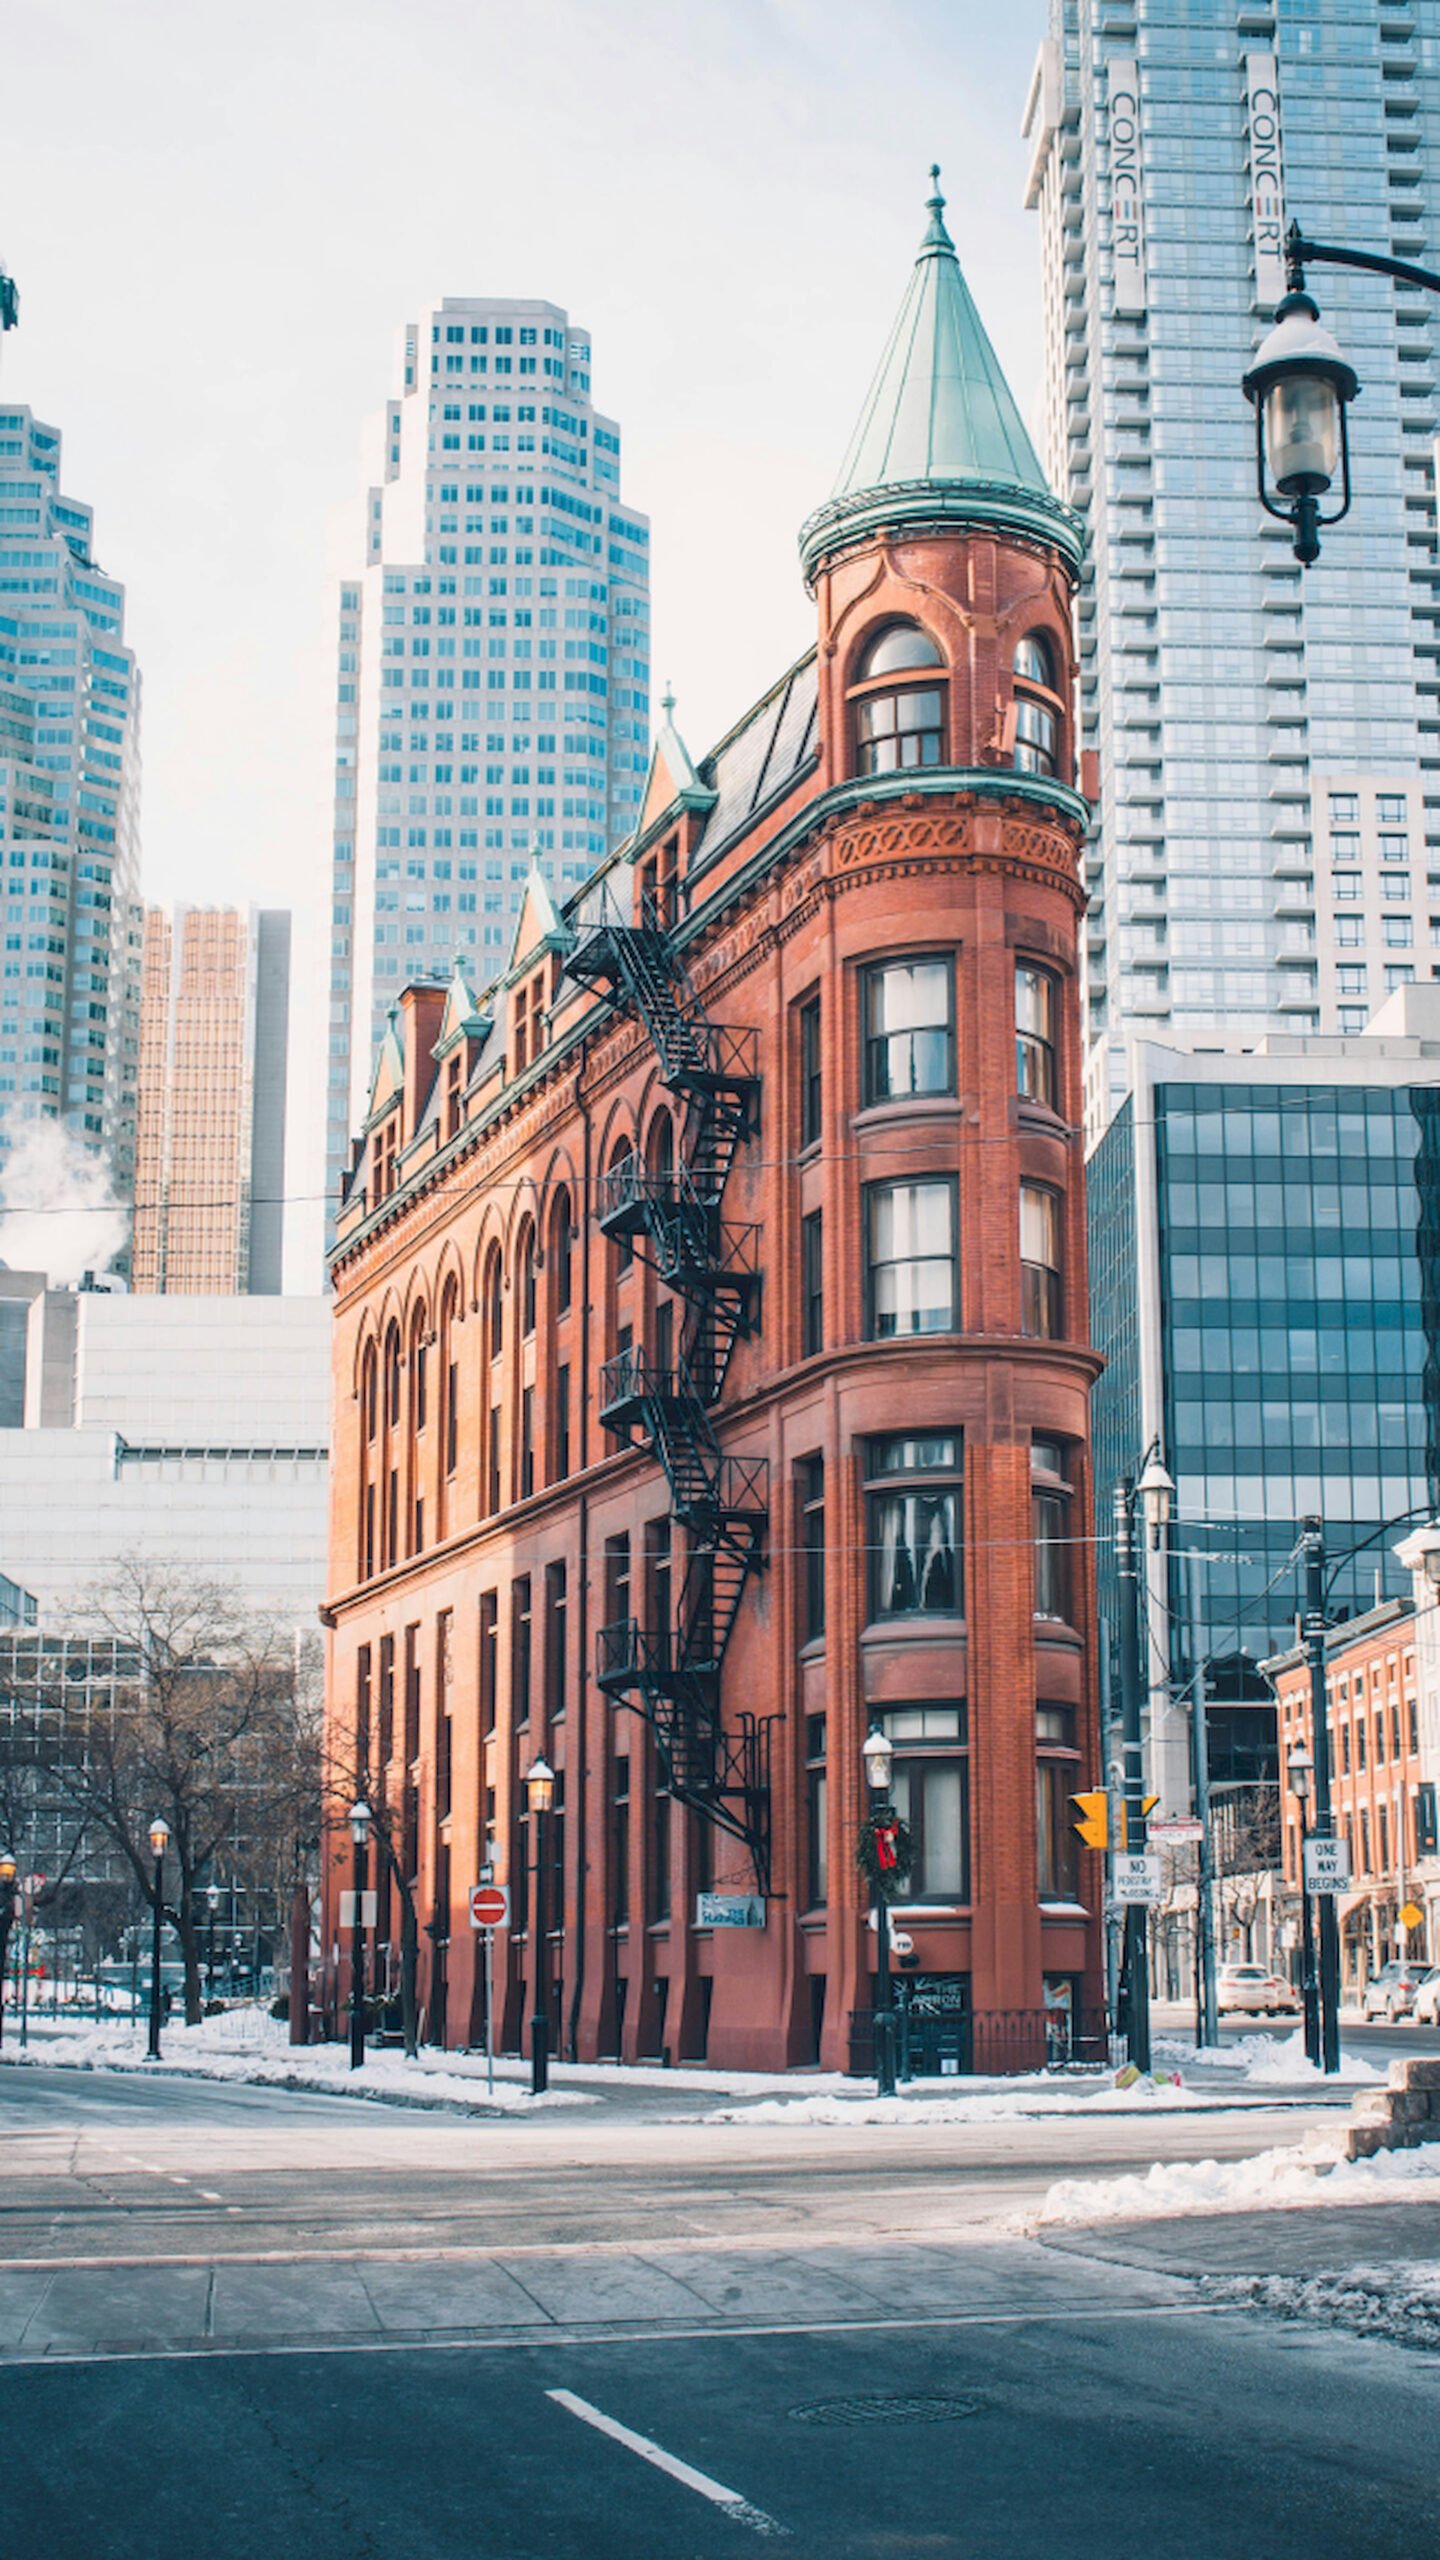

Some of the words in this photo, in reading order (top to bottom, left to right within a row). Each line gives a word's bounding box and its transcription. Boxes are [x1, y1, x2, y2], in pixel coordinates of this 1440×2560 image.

[1111, 91, 1139, 267] CONCERT
[1251, 88, 1282, 263] CONCERT
[1315, 1844, 1337, 1856] ONE
[1129, 1860, 1147, 1874] NO
[1317, 1860, 1338, 1872] WAY
[1308, 1878, 1348, 1890] BEGINS
